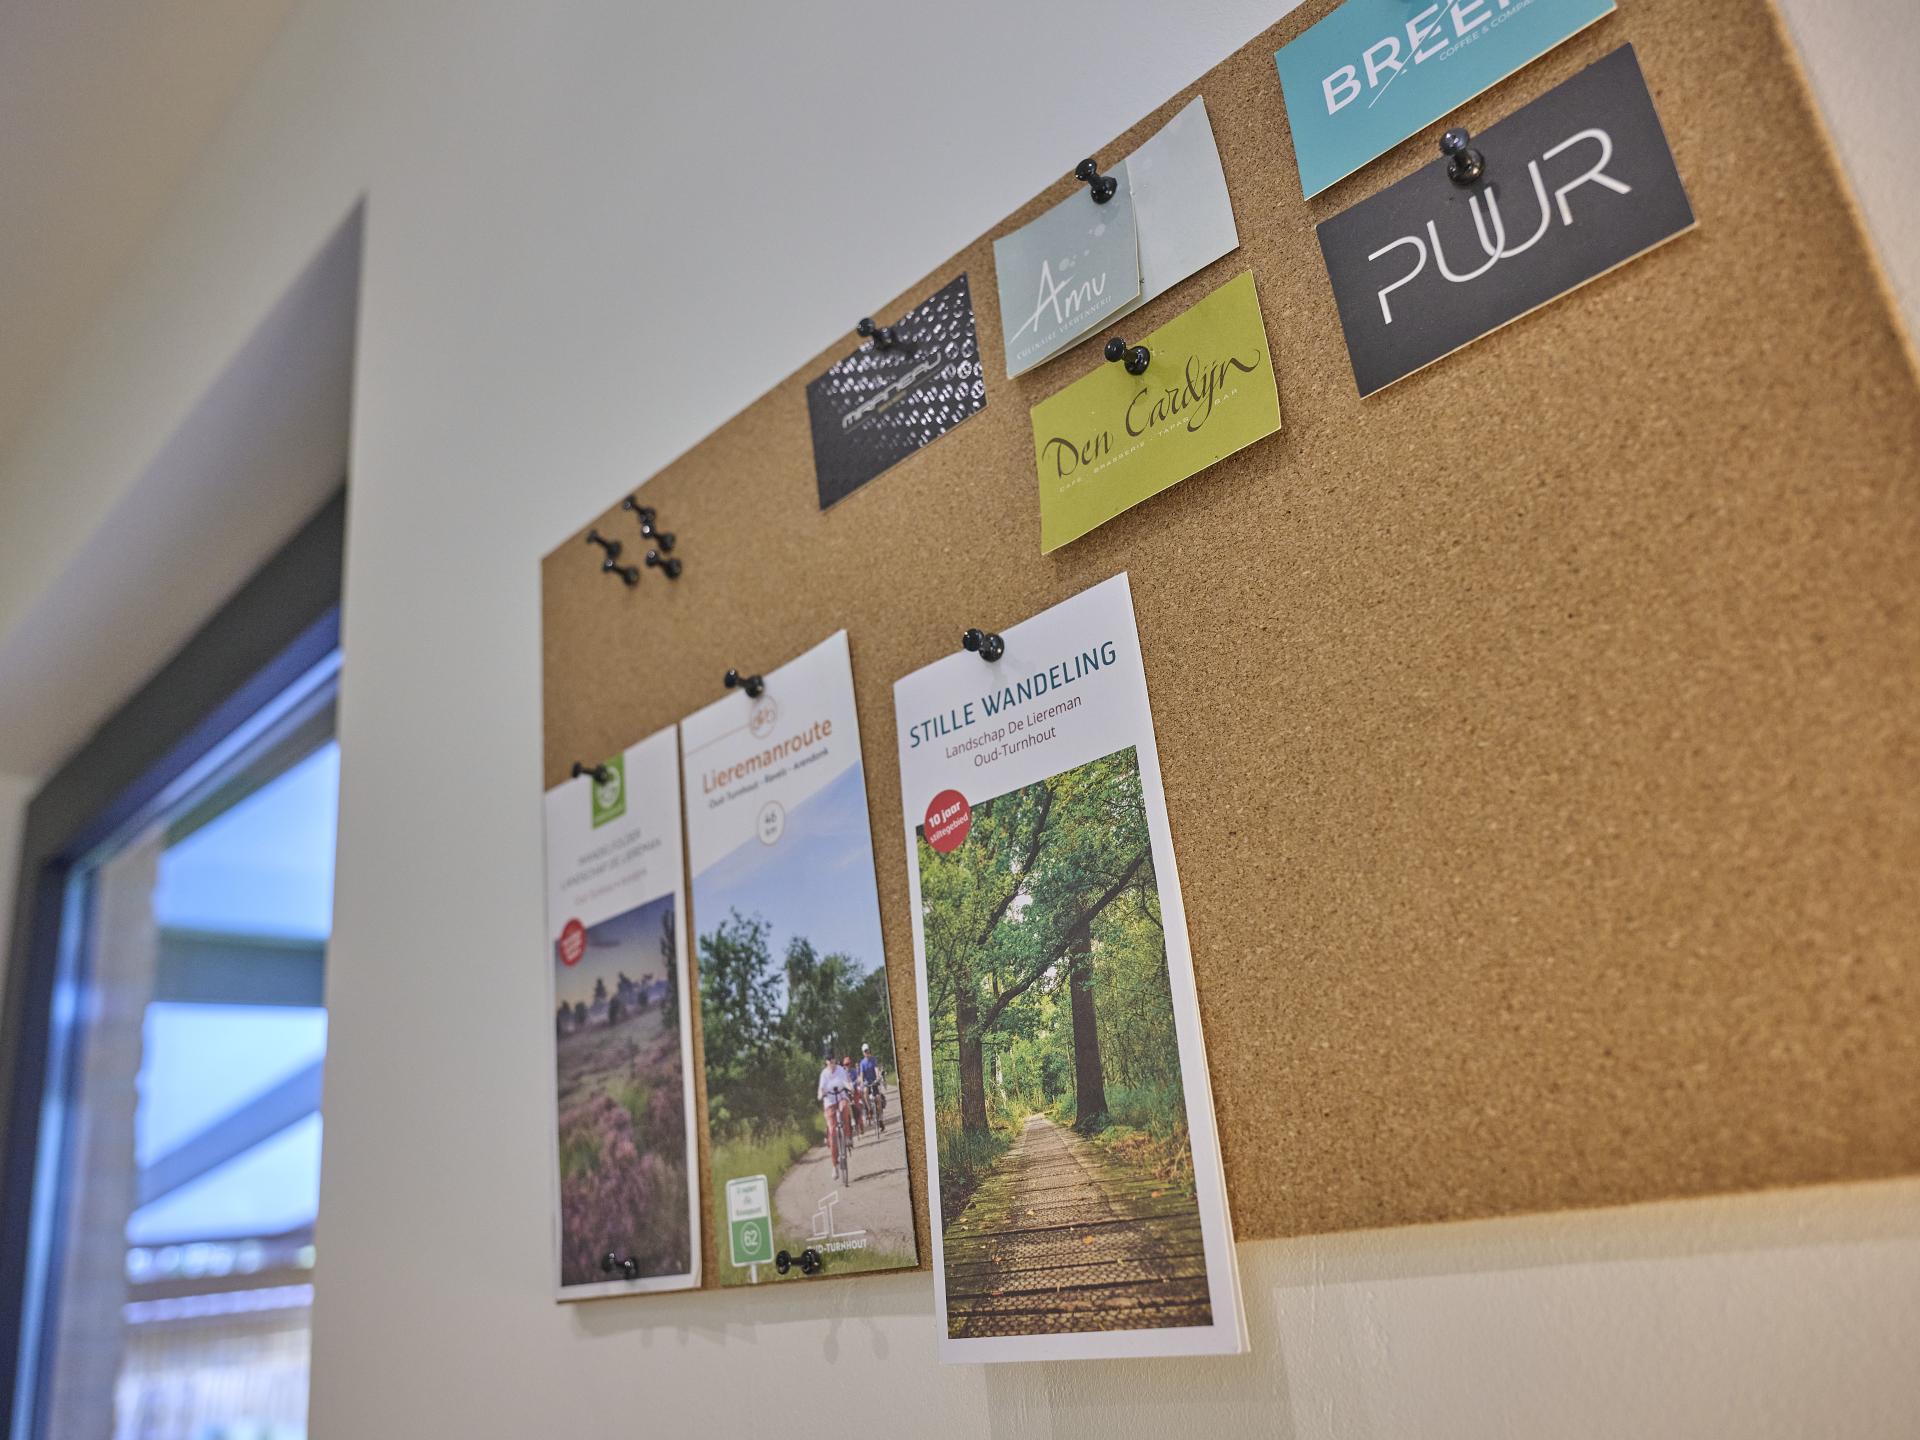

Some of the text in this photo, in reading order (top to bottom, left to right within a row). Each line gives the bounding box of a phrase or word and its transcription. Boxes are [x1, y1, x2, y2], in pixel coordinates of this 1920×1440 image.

[1321, 0, 1510, 116] BREE
[1439, 30, 1480, 62] COFFEE
[1368, 127, 1632, 325] PUUR
[1042, 348, 1261, 479] Den Cardijn
[910, 641, 1117, 748] STILLE WANDELING
[945, 696, 1082, 759] Landschap De Liereman
[703, 719, 833, 795] Lieremanroute
[973, 726, 1057, 767] Oud-Turnhout
[928, 800, 962, 829] 10 jaar
[929, 812, 969, 844] stiltegebied
